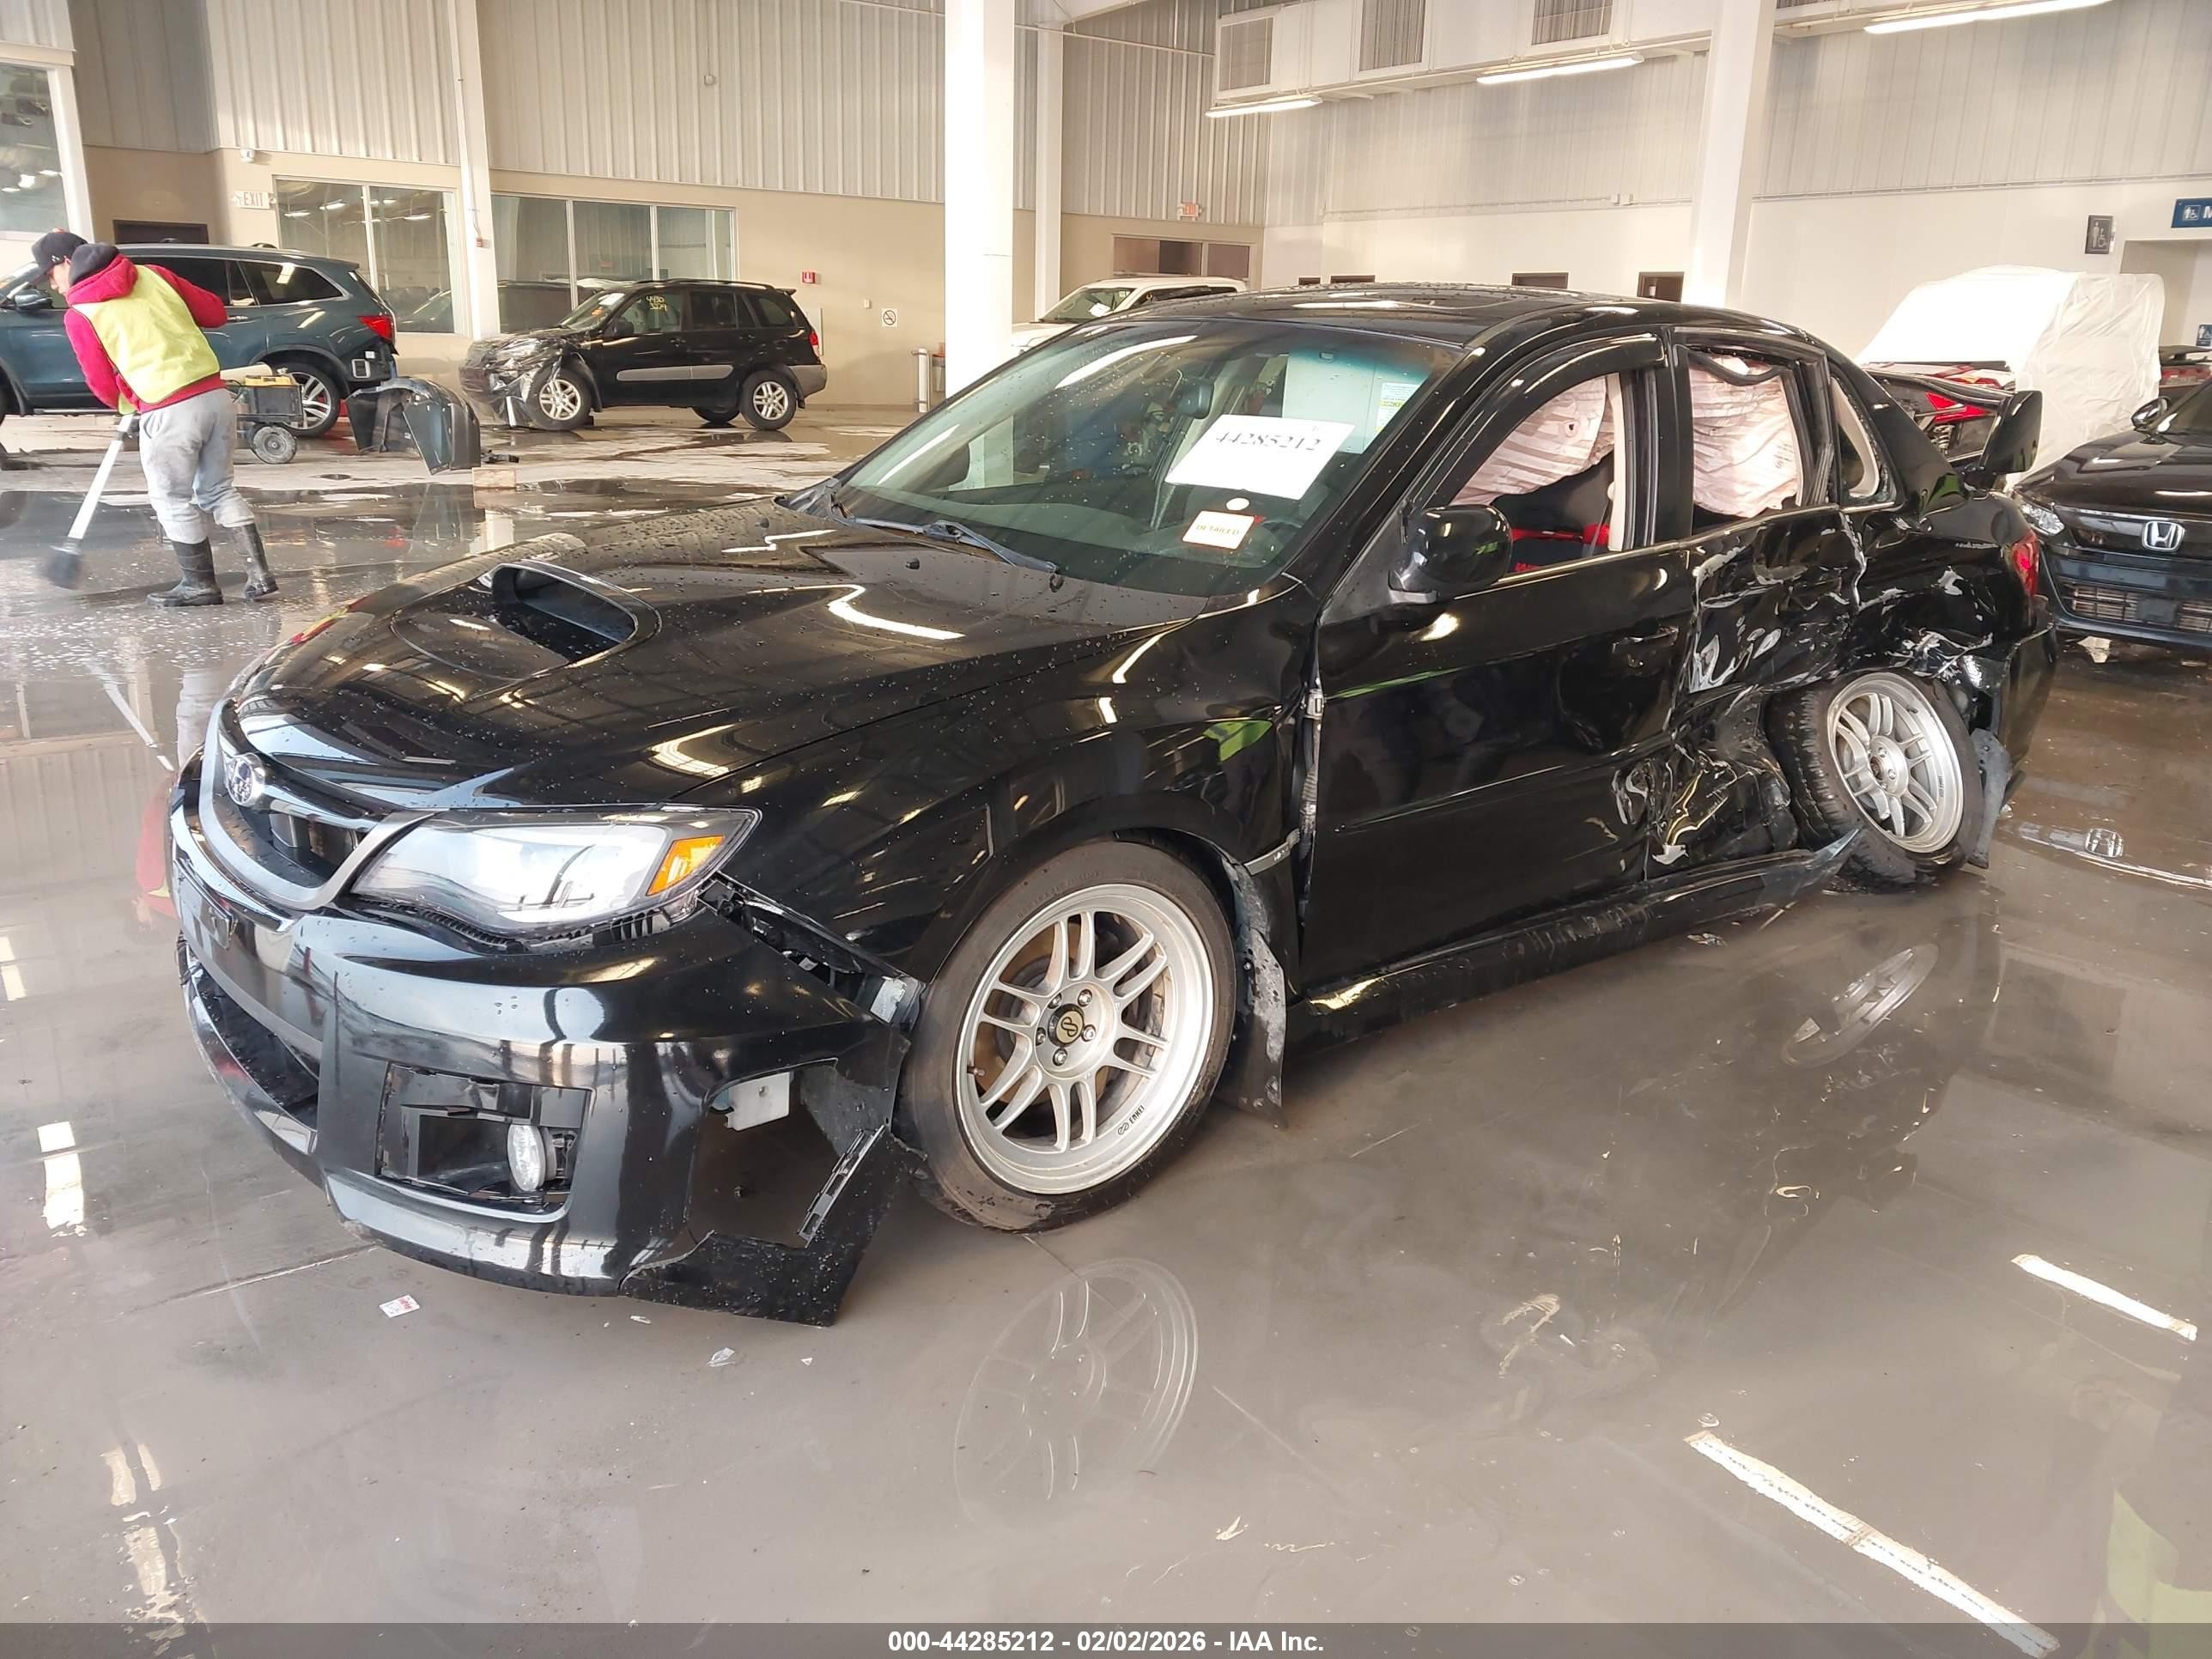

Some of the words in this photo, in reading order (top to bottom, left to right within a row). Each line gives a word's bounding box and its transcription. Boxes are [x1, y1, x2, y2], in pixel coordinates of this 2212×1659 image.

[243, 191, 263, 206] EXIT
[1216, 431, 1321, 451] 44285212
[1128, 1104, 1145, 1124] ENKEI
